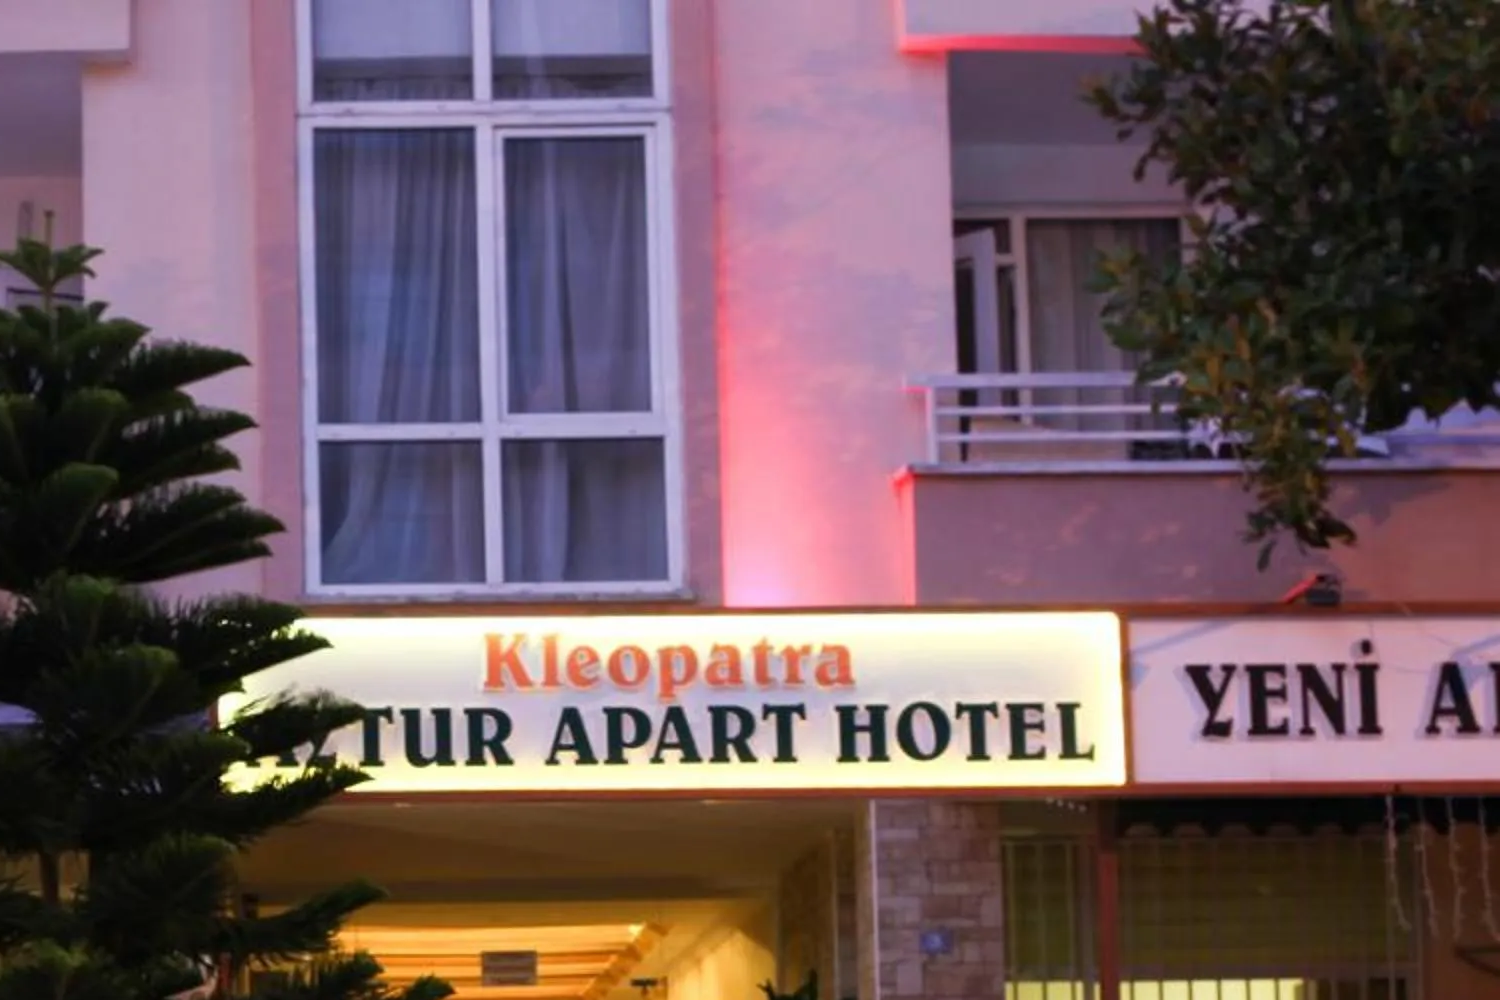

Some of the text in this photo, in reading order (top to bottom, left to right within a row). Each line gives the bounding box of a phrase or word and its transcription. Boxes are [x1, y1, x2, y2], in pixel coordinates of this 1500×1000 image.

[484, 633, 855, 698] Kleopatra
[1185, 638, 1383, 737] YENİ
[546, 705, 806, 765] APART
[838, 702, 1095, 762] HOTEL
